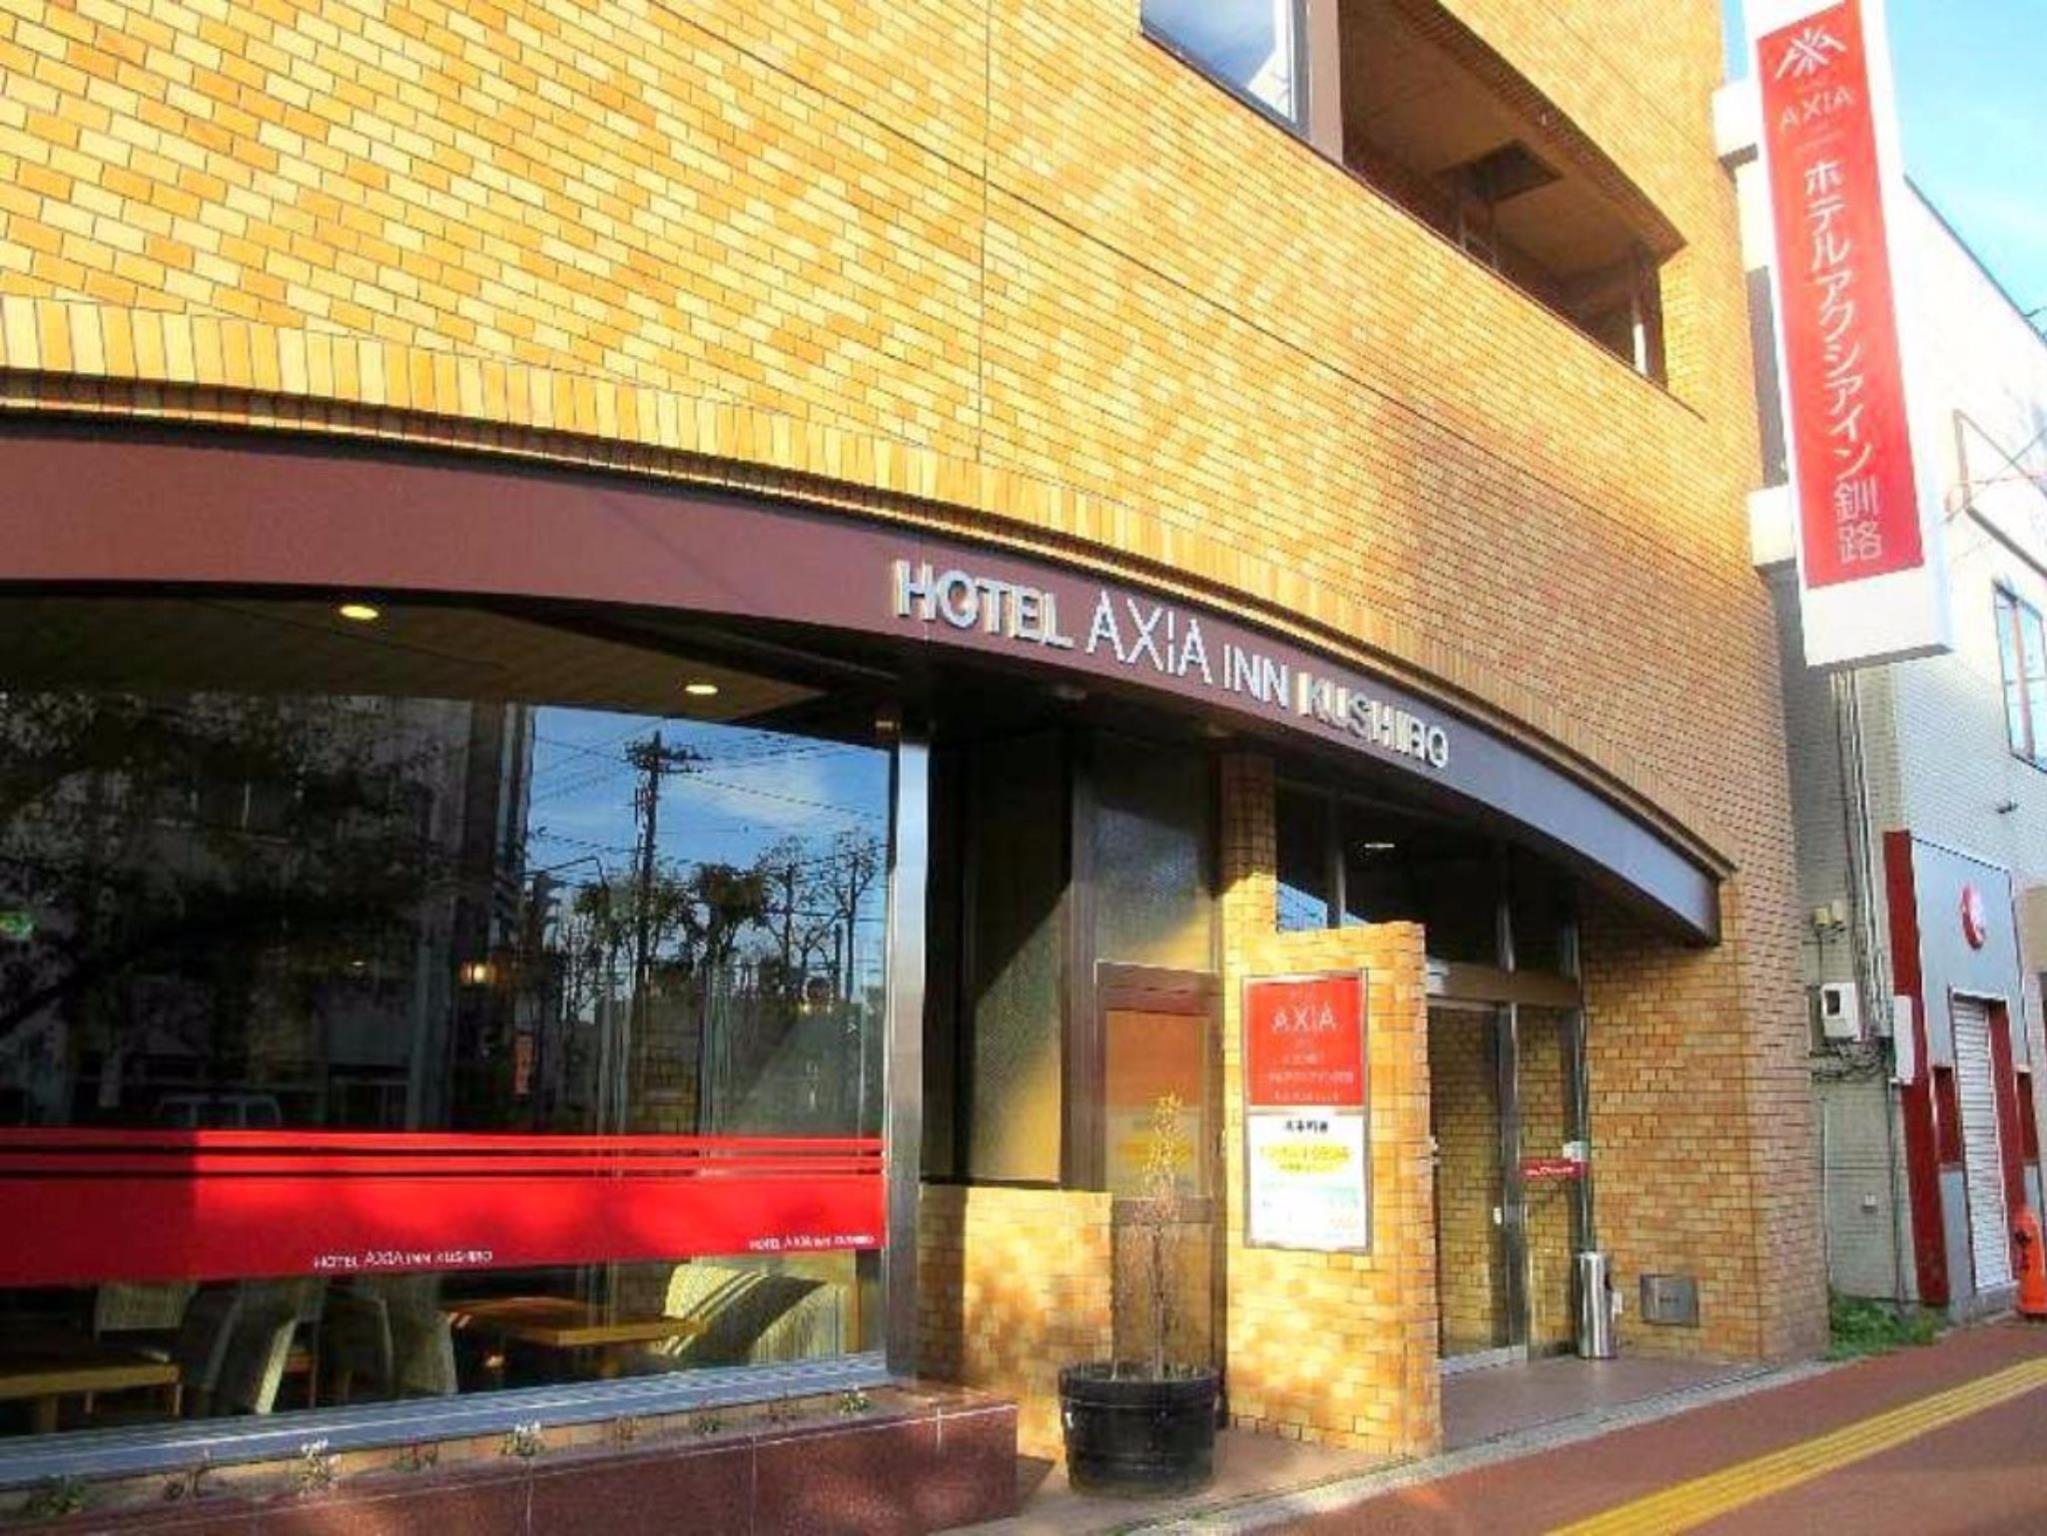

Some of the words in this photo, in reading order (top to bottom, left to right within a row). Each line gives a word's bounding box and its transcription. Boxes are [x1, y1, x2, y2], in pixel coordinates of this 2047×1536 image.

[1779, 86, 1854, 132] AXIA
[1804, 159, 1882, 565] ホテルアクシアイン釧路
[893, 559, 1075, 650] HOTEL
[1085, 589, 1214, 686] AXIA
[1223, 642, 1288, 710] INN
[1296, 671, 1449, 768] KUSHIRO
[1271, 1000, 1338, 1034] AXIA
